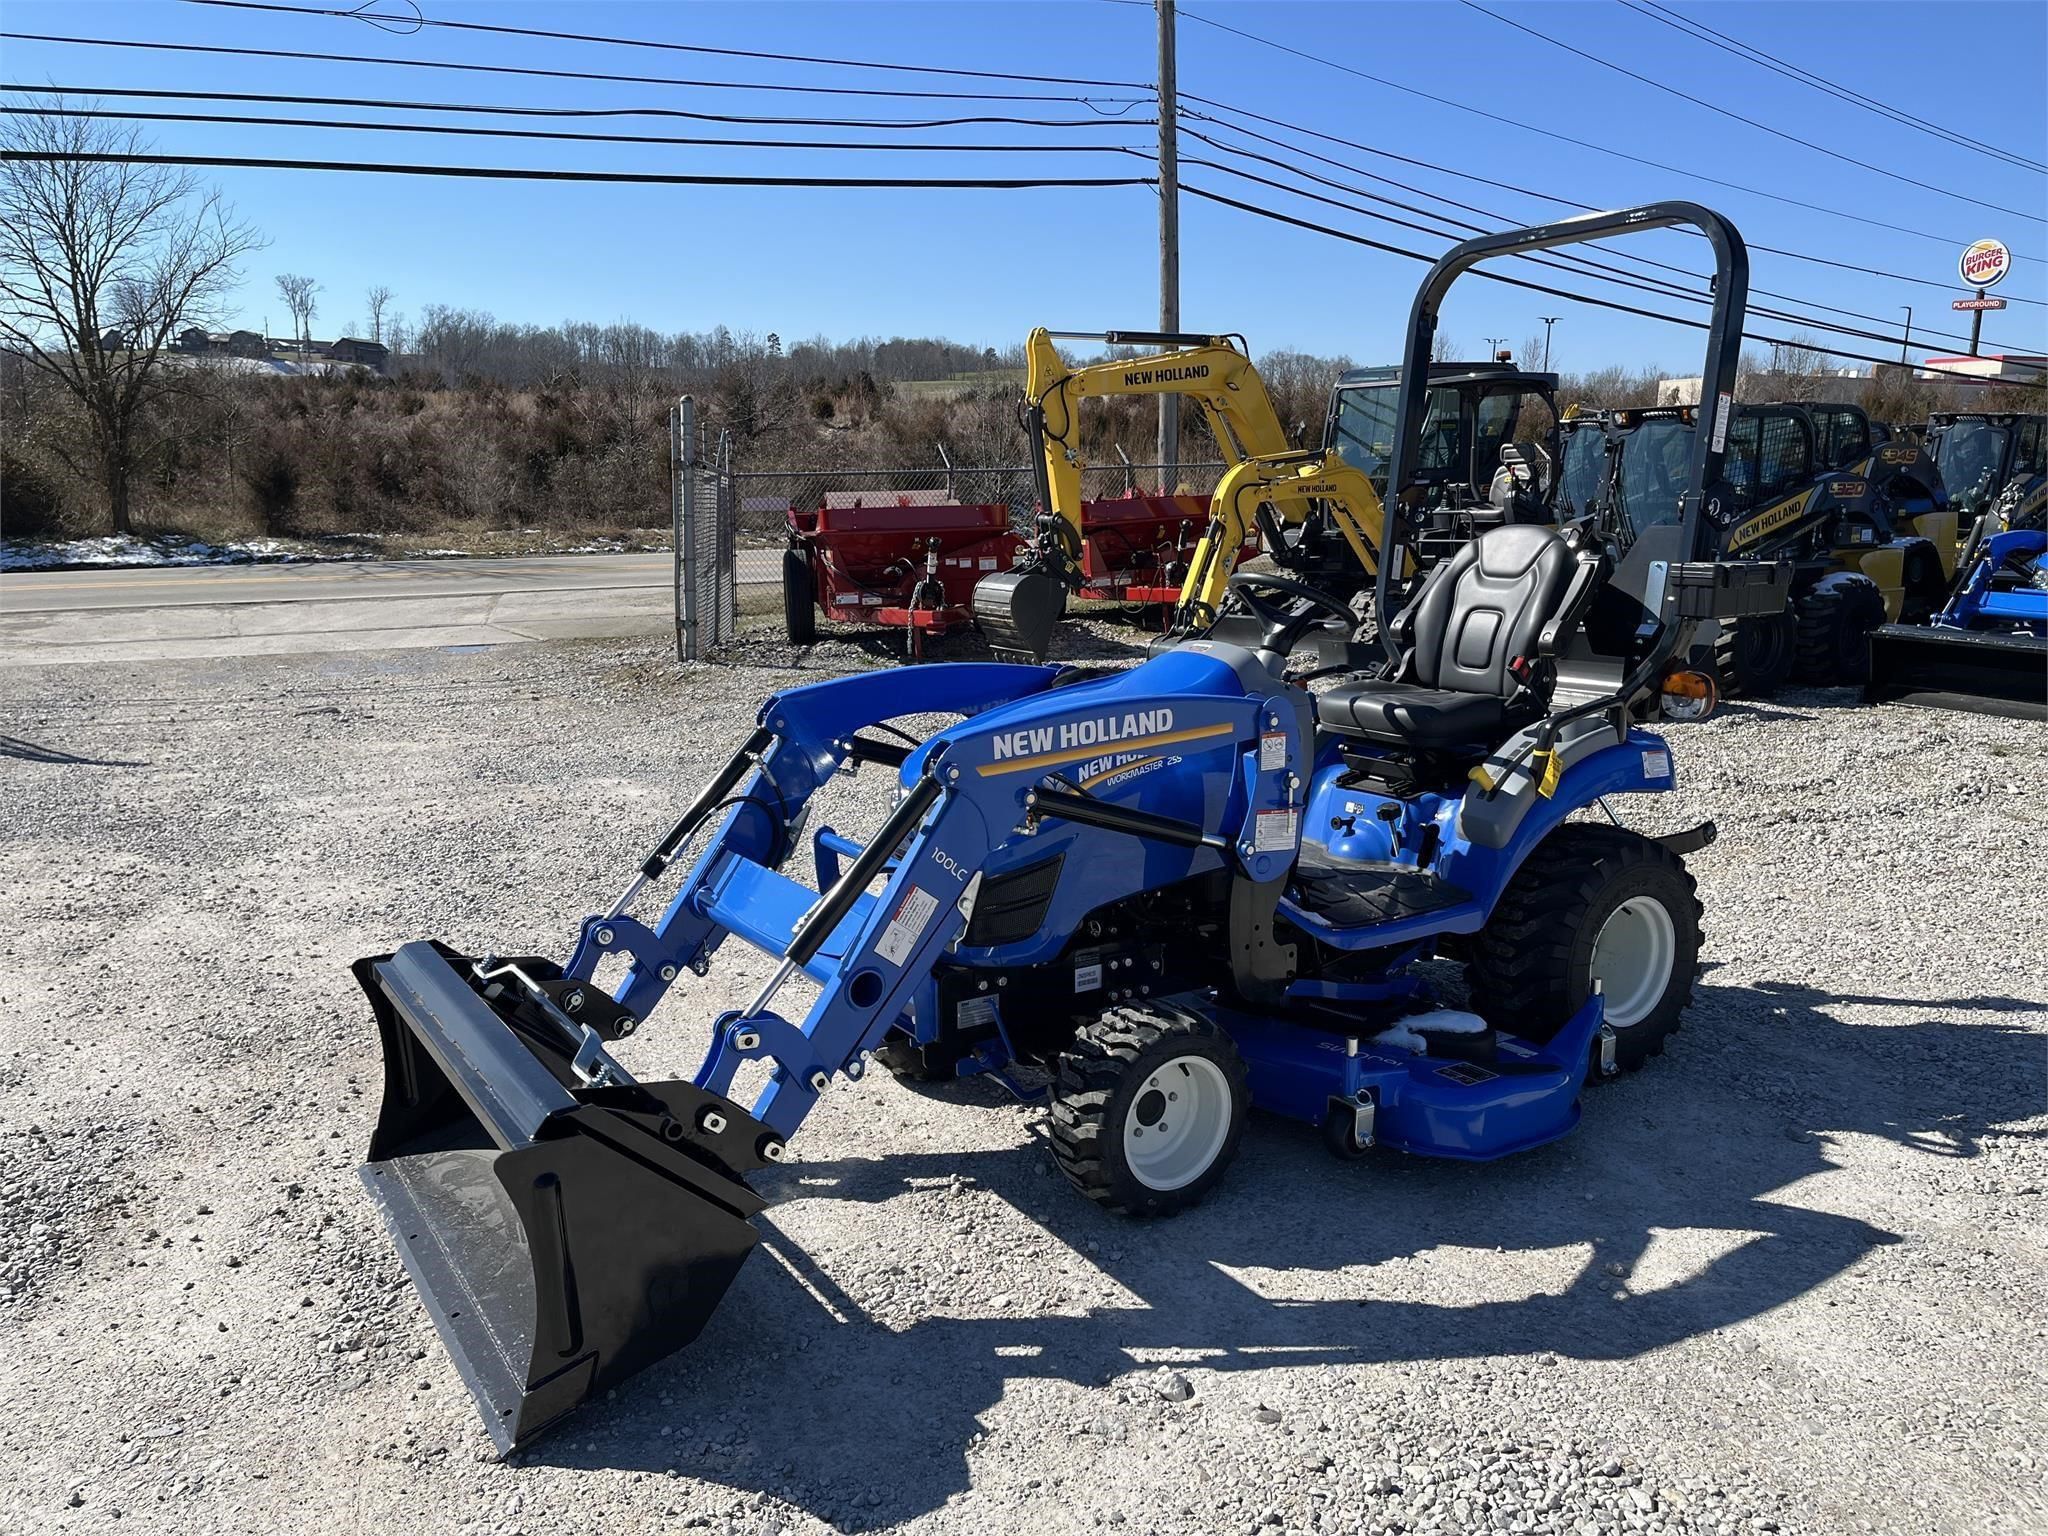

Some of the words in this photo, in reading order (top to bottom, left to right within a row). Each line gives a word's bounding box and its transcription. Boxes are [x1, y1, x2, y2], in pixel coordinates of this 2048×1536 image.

[1966, 248, 2003, 265] BURGER
[1966, 256, 2003, 276] KING
[1953, 300, 2000, 309] PLAYGROUND
[1124, 370, 1152, 386] NEW
[1155, 364, 1209, 383] HOLLAND
[1298, 484, 1311, 494] NEW
[1311, 484, 1337, 493] HOLLAND
[1738, 521, 1760, 541] NEW
[1761, 501, 1801, 530] HOLLAND
[992, 727, 1054, 760] NEW
[1060, 708, 1173, 748] HOLLAND
[1078, 755, 1112, 783] NEW
[1106, 760, 1164, 787] WORKMASTER
[931, 846, 968, 882] 100LC
